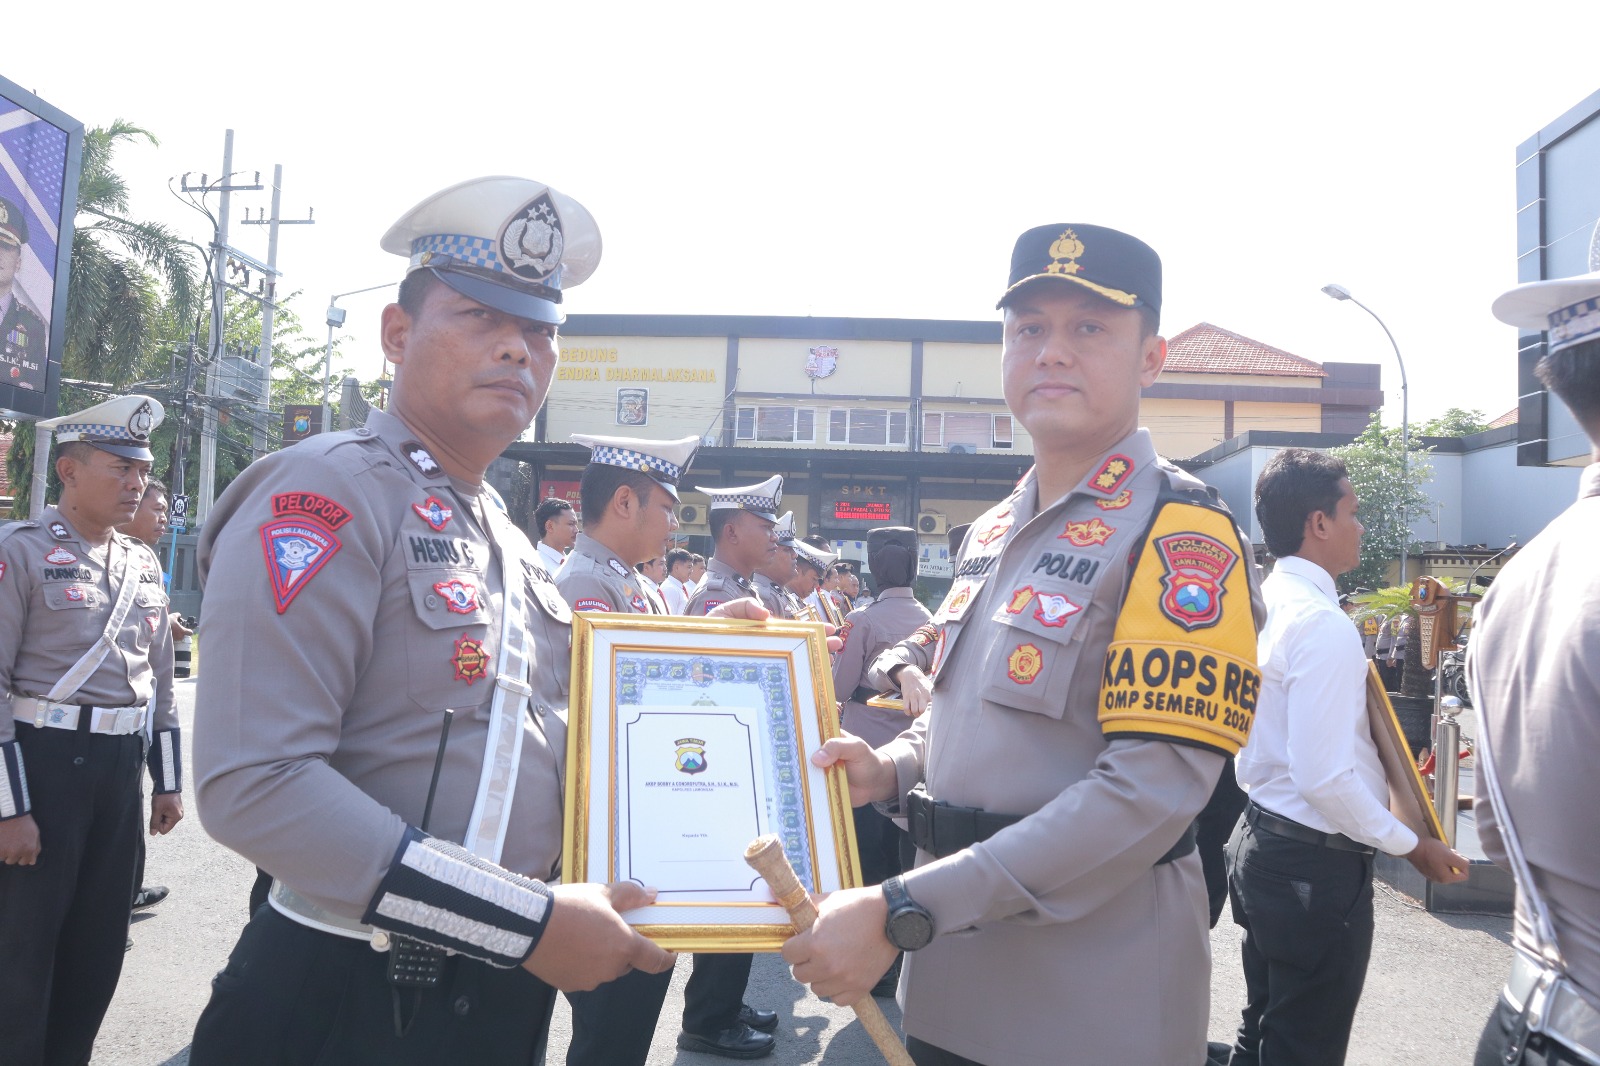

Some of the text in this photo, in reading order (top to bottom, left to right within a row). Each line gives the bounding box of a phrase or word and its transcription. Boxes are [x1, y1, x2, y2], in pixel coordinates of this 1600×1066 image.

[560, 348, 618, 362] GEDUNG
[605, 367, 717, 383] DHARMALAKSANA
[841, 485, 886, 496] SPKT
[279, 494, 343, 525] PELOPOR
[409, 536, 460, 564] HERU
[1168, 540, 1228, 559] POLRES
[1169, 546, 1226, 564] LAMONGAN
[44, 567, 93, 581] PURNOMO
[1032, 552, 1100, 586] POLRI
[1174, 558, 1220, 576] JAWA TIMUR
[1103, 647, 1261, 715] KA OPS RES
[1105, 690, 1251, 735] OMP SEMERU 2024
